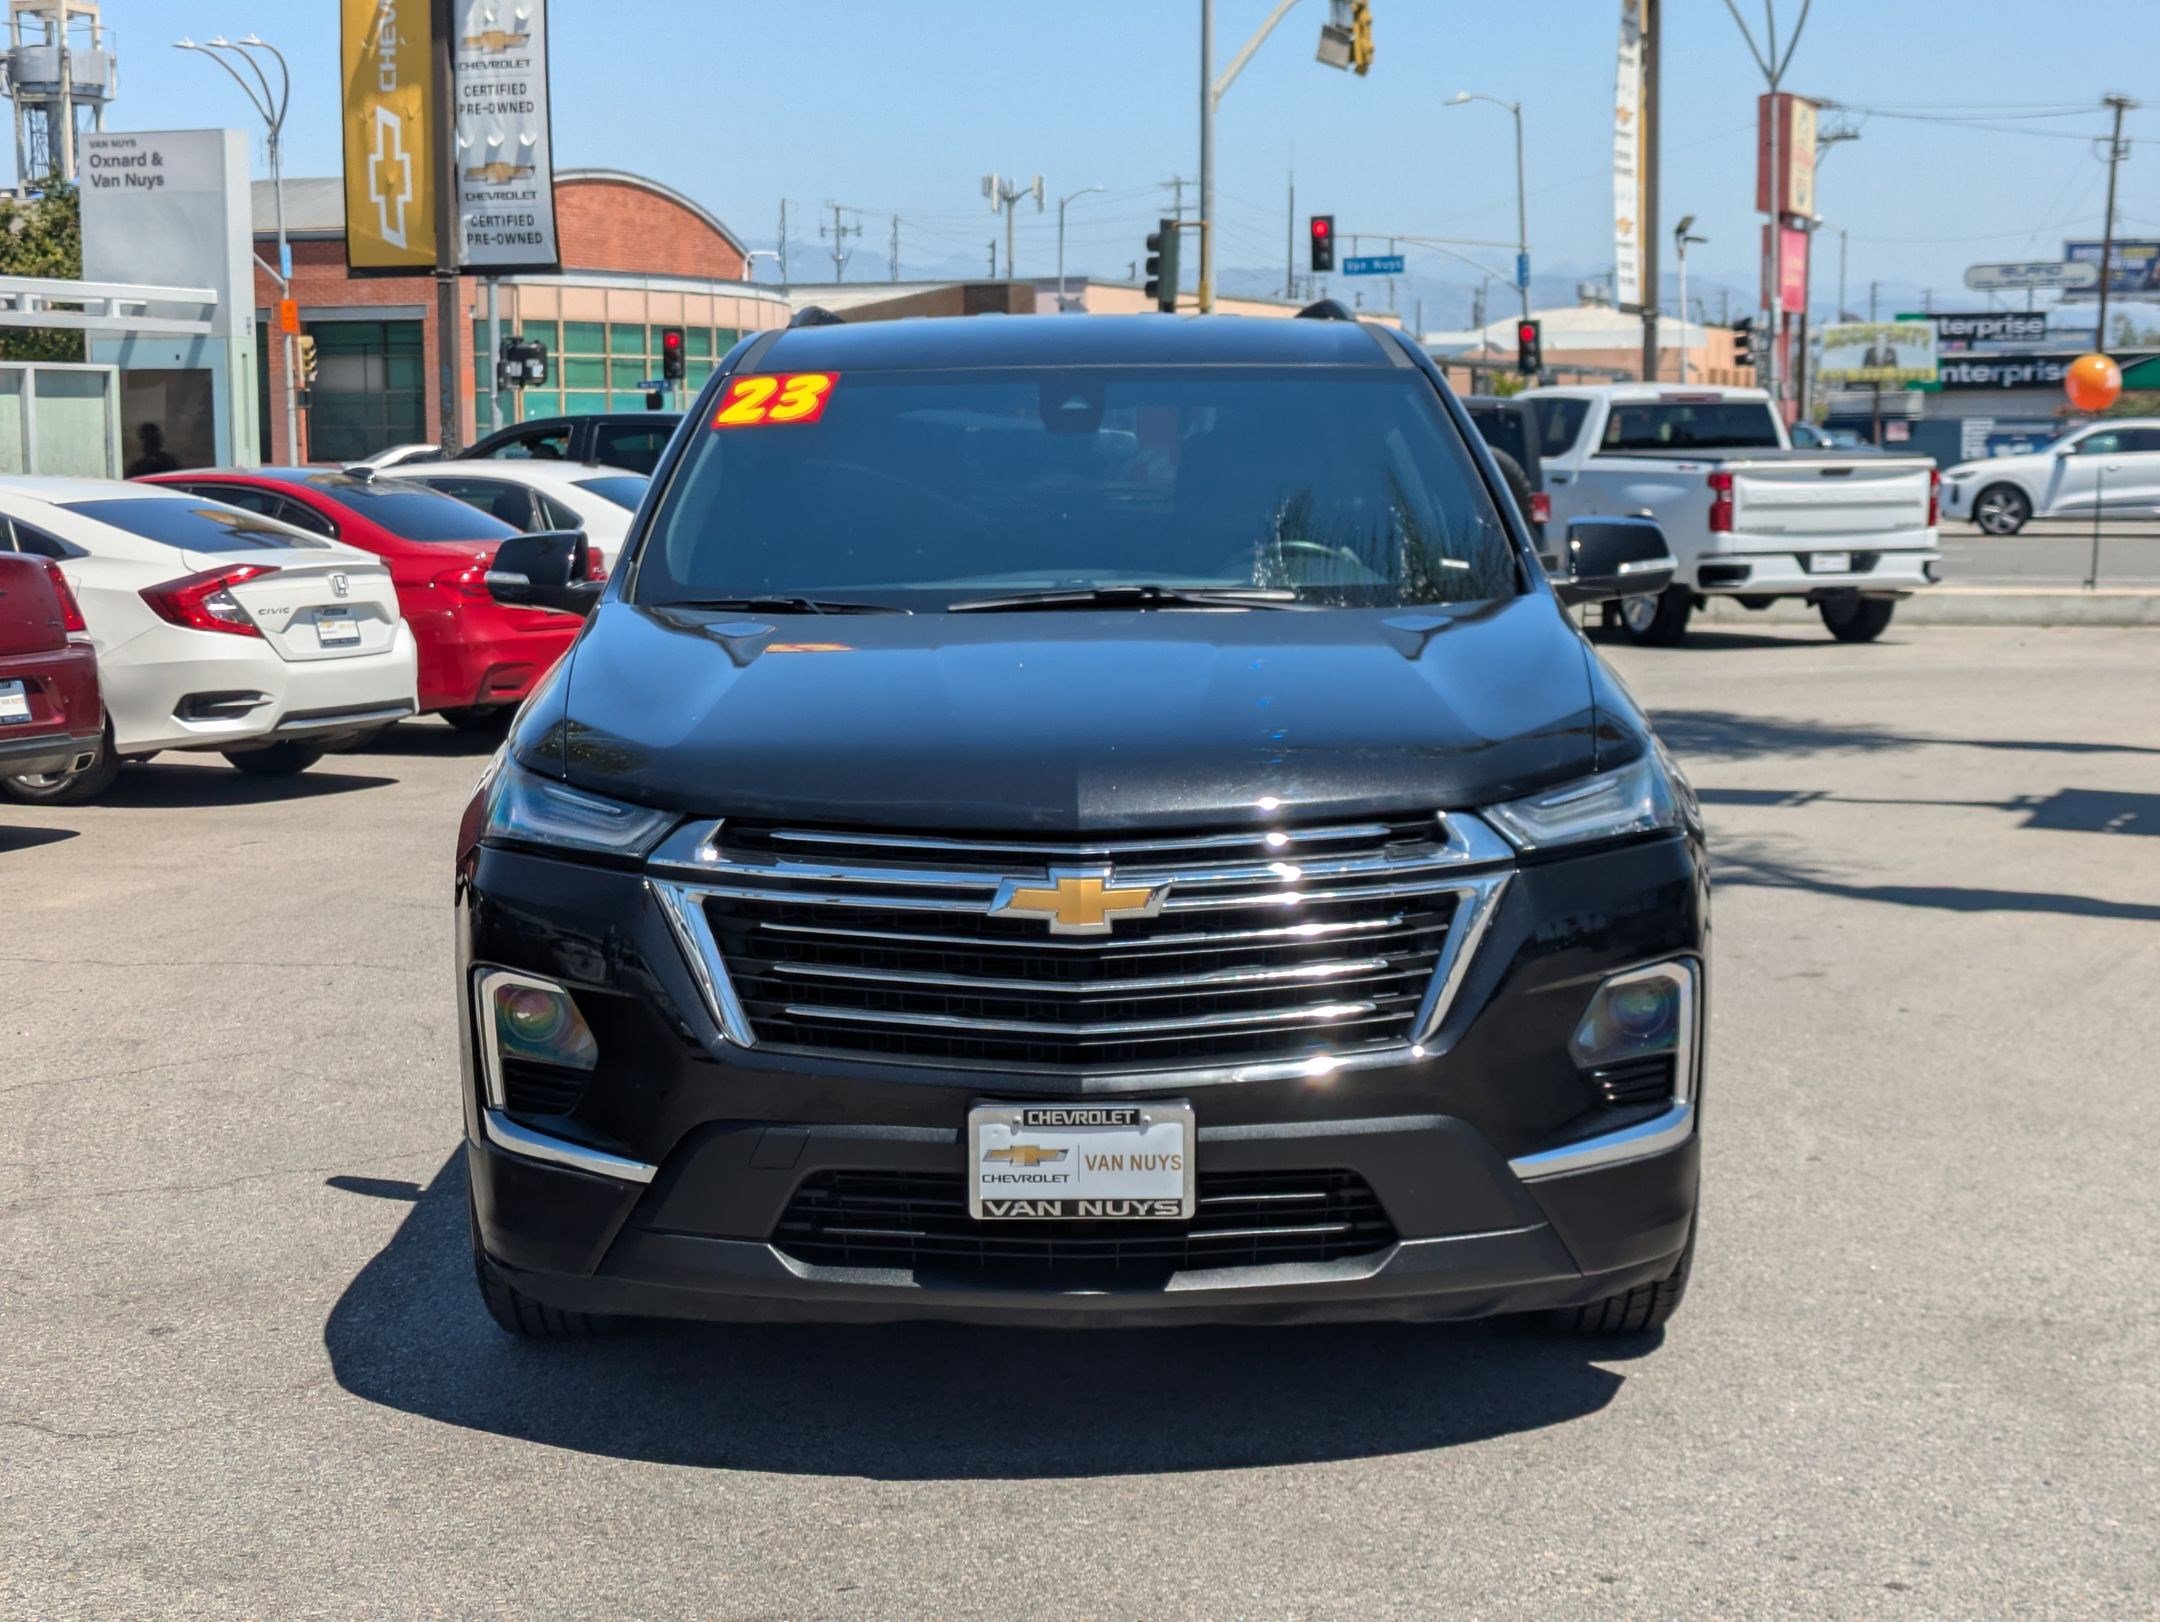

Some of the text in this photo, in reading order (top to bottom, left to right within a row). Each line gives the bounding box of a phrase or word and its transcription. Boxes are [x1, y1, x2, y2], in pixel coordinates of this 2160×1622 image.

[459, 58, 531, 71] CHEVROLET
[464, 82, 527, 97] CERTIFIED
[459, 101, 535, 115] PRE-OWNED
[89, 139, 136, 149] VAN NUYS
[89, 152, 163, 168] Oxnard &
[91, 173, 164, 190] Van Nuys
[465, 190, 537, 202] CHEVROLET
[471, 214, 535, 228] CERTIFIED
[467, 232, 543, 246] PRE-OWNED
[1941, 314, 2043, 339] terprise
[1941, 359, 2067, 387] nterpris
[717, 374, 832, 425] 23
[258, 607, 290, 616] CIVIC
[1027, 1110, 1136, 1126] CHEVROLET
[1085, 1154, 1183, 1171] VAN NUYS
[982, 1174, 1070, 1184] CHEVROLET
[985, 1200, 1181, 1217] VAN NUYS
